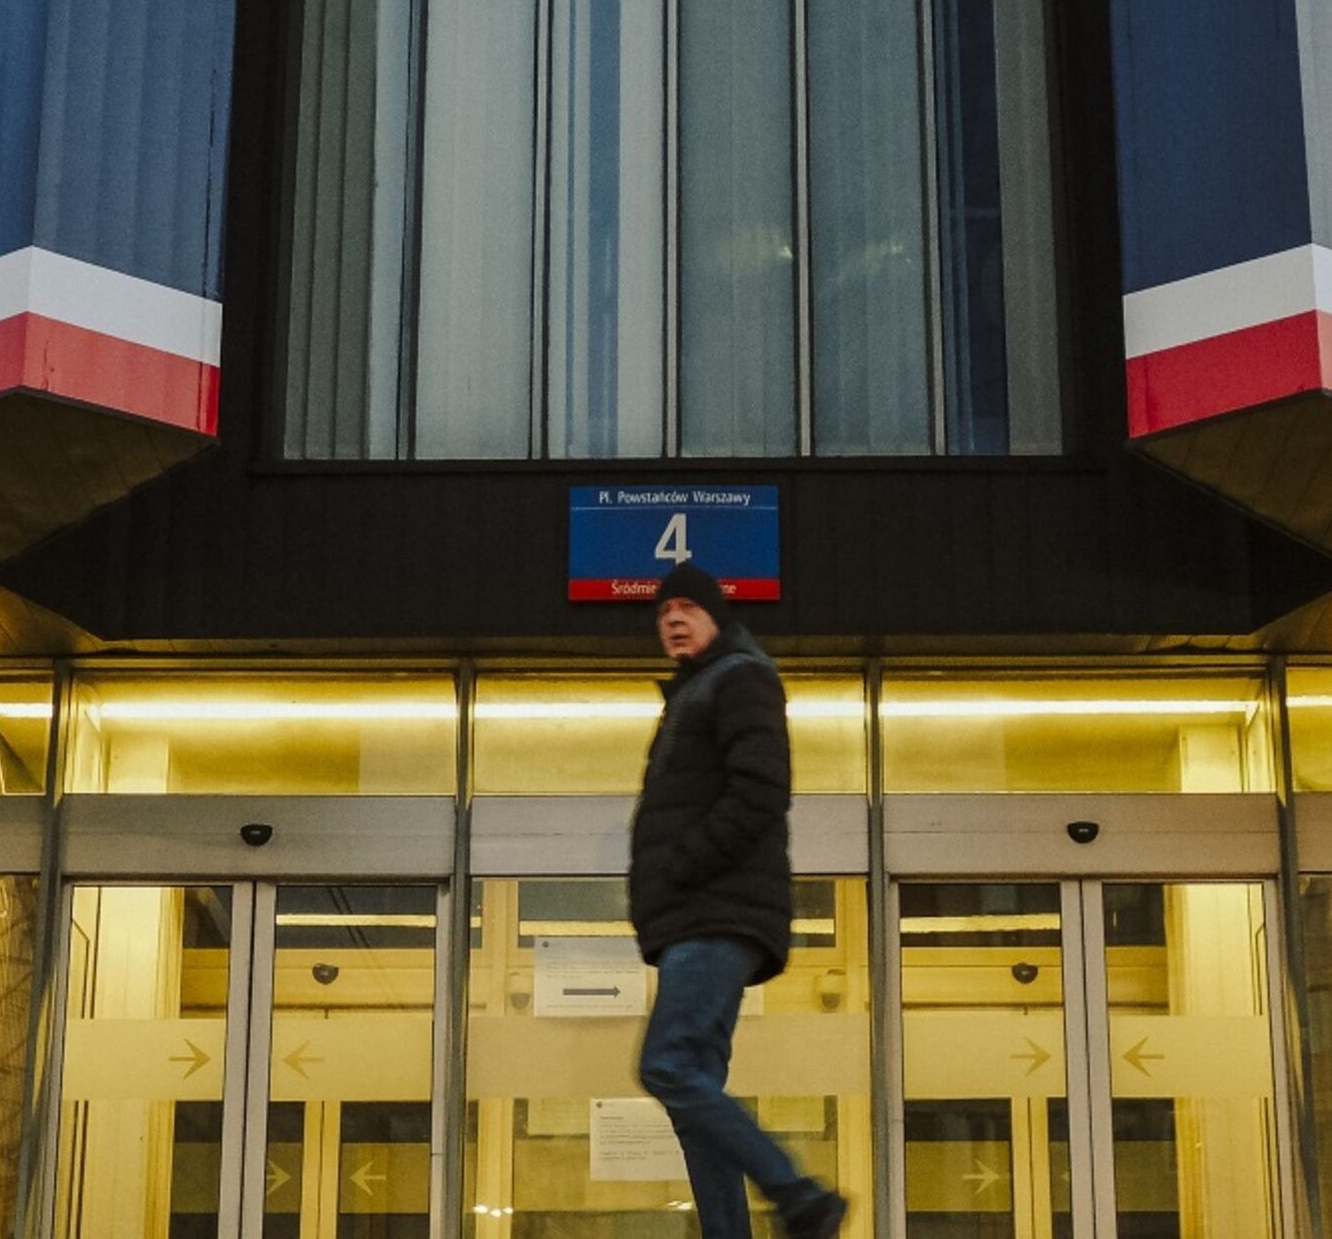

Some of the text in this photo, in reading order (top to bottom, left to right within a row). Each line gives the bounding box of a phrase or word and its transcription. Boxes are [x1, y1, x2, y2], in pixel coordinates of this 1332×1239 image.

[618, 490, 688, 504] Powstańców
[694, 491, 751, 506] Warszawy
[654, 512, 693, 566] 4
